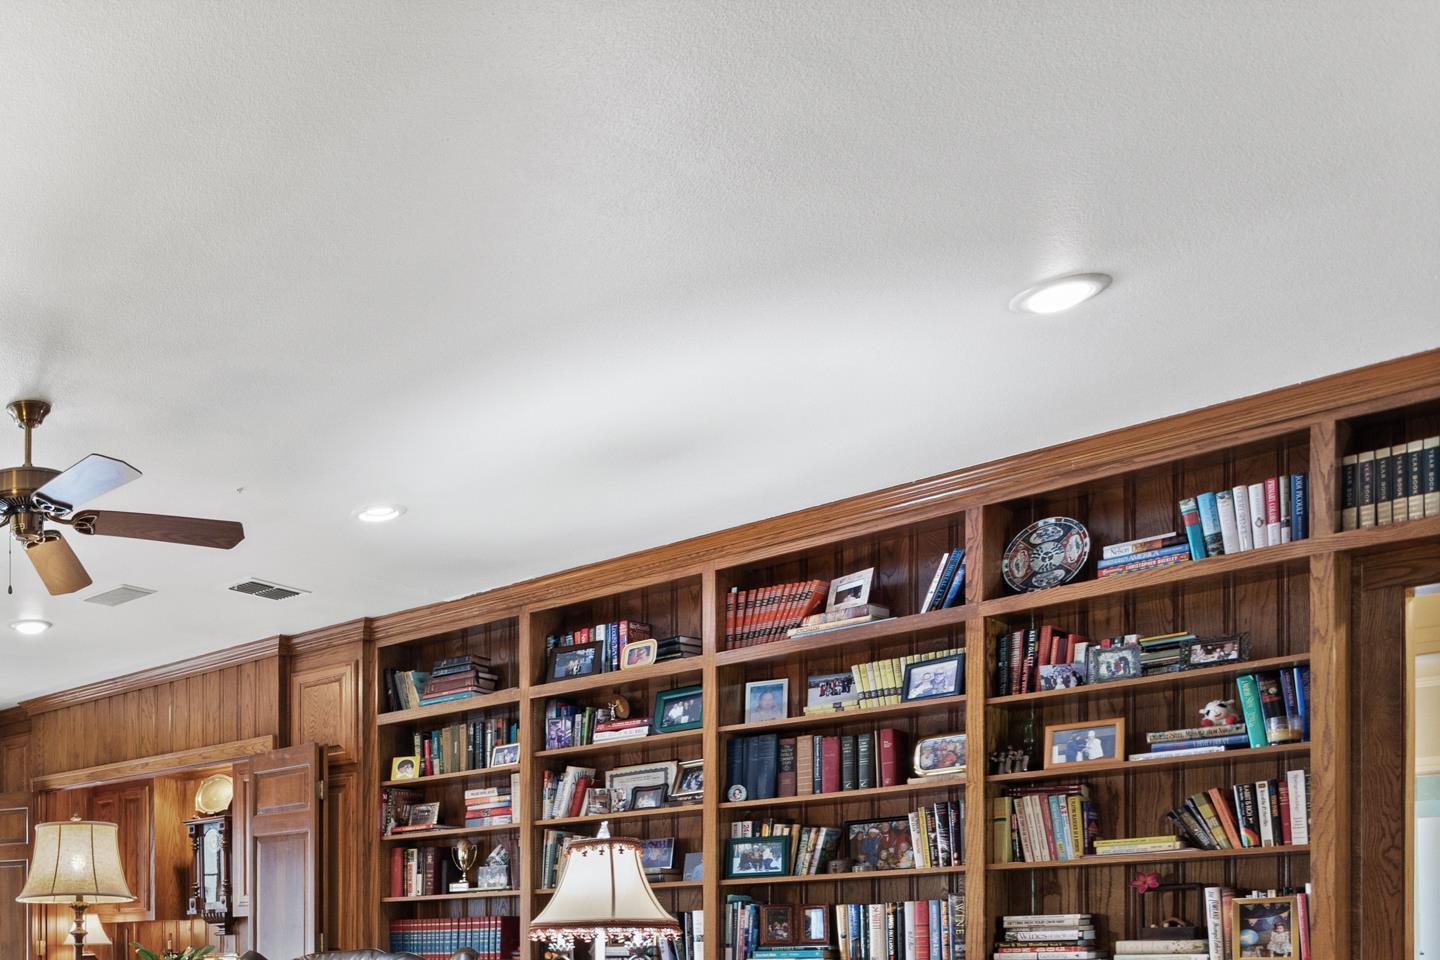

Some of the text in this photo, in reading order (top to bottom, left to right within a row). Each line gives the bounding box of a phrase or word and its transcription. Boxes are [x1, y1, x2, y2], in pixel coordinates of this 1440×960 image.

[1411, 453, 1419, 494] YEAR BOOK
[1427, 449, 1435, 491] YEAR BOOK
[1295, 475, 1303, 490] JODI
[1396, 477, 1404, 497] BOOK
[1295, 490, 1303, 515] PICOULT
[1363, 484, 1371, 504] BOOK
[1028, 630, 1036, 641] KEN
